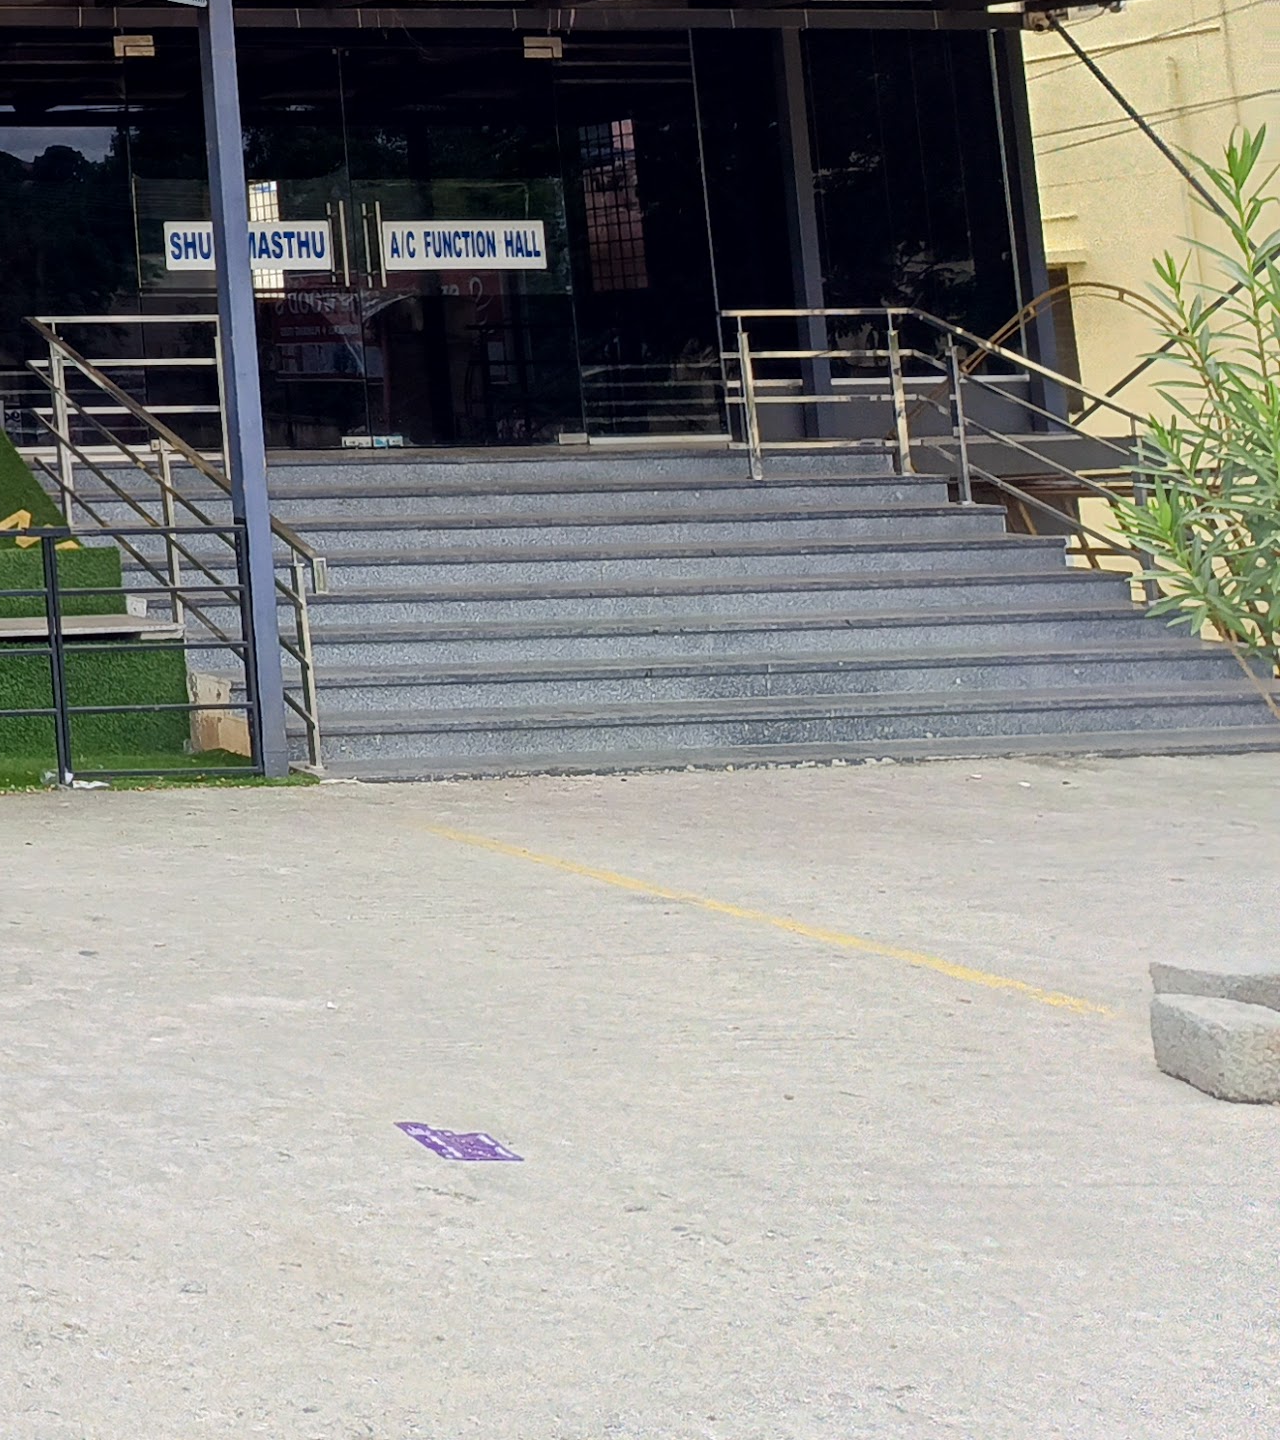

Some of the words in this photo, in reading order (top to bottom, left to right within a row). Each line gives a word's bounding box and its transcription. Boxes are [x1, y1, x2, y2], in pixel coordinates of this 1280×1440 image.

[170, 231, 326, 260] SHUASTHU
[390, 231, 417, 258] A/C
[424, 231, 496, 258] FUNCTION
[505, 230, 541, 257] HALL
